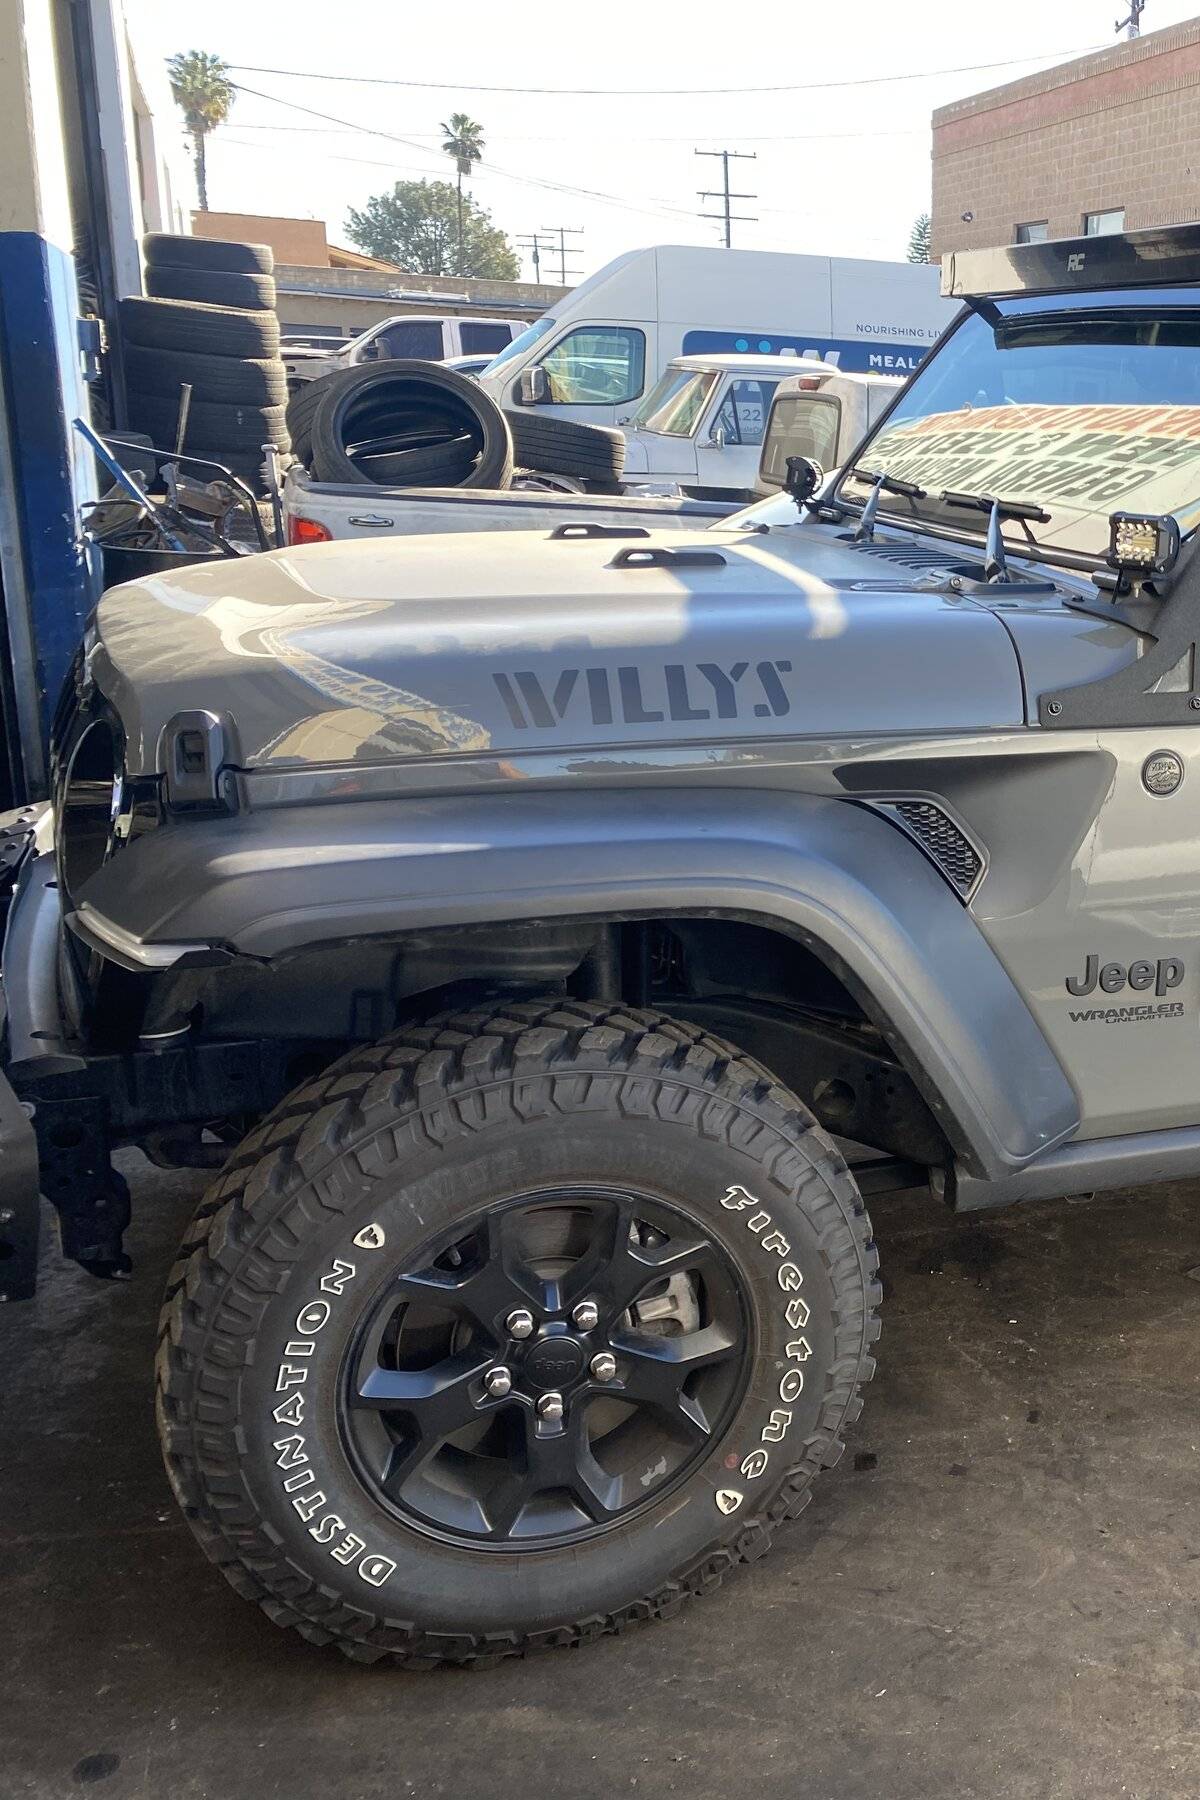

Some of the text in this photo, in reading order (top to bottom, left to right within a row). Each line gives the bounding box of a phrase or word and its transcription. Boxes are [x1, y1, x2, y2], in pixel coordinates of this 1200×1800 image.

[856, 323, 924, 338] NOURISHING
[491, 660, 793, 730] WILLYS
[1065, 954, 1185, 997] Jeep
[1068, 1002, 1185, 1023] WRANGLER
[1105, 1011, 1185, 1024] UNLIMITED
[719, 1184, 815, 1480] Firestone
[273, 1258, 398, 1588] DESTINATION
